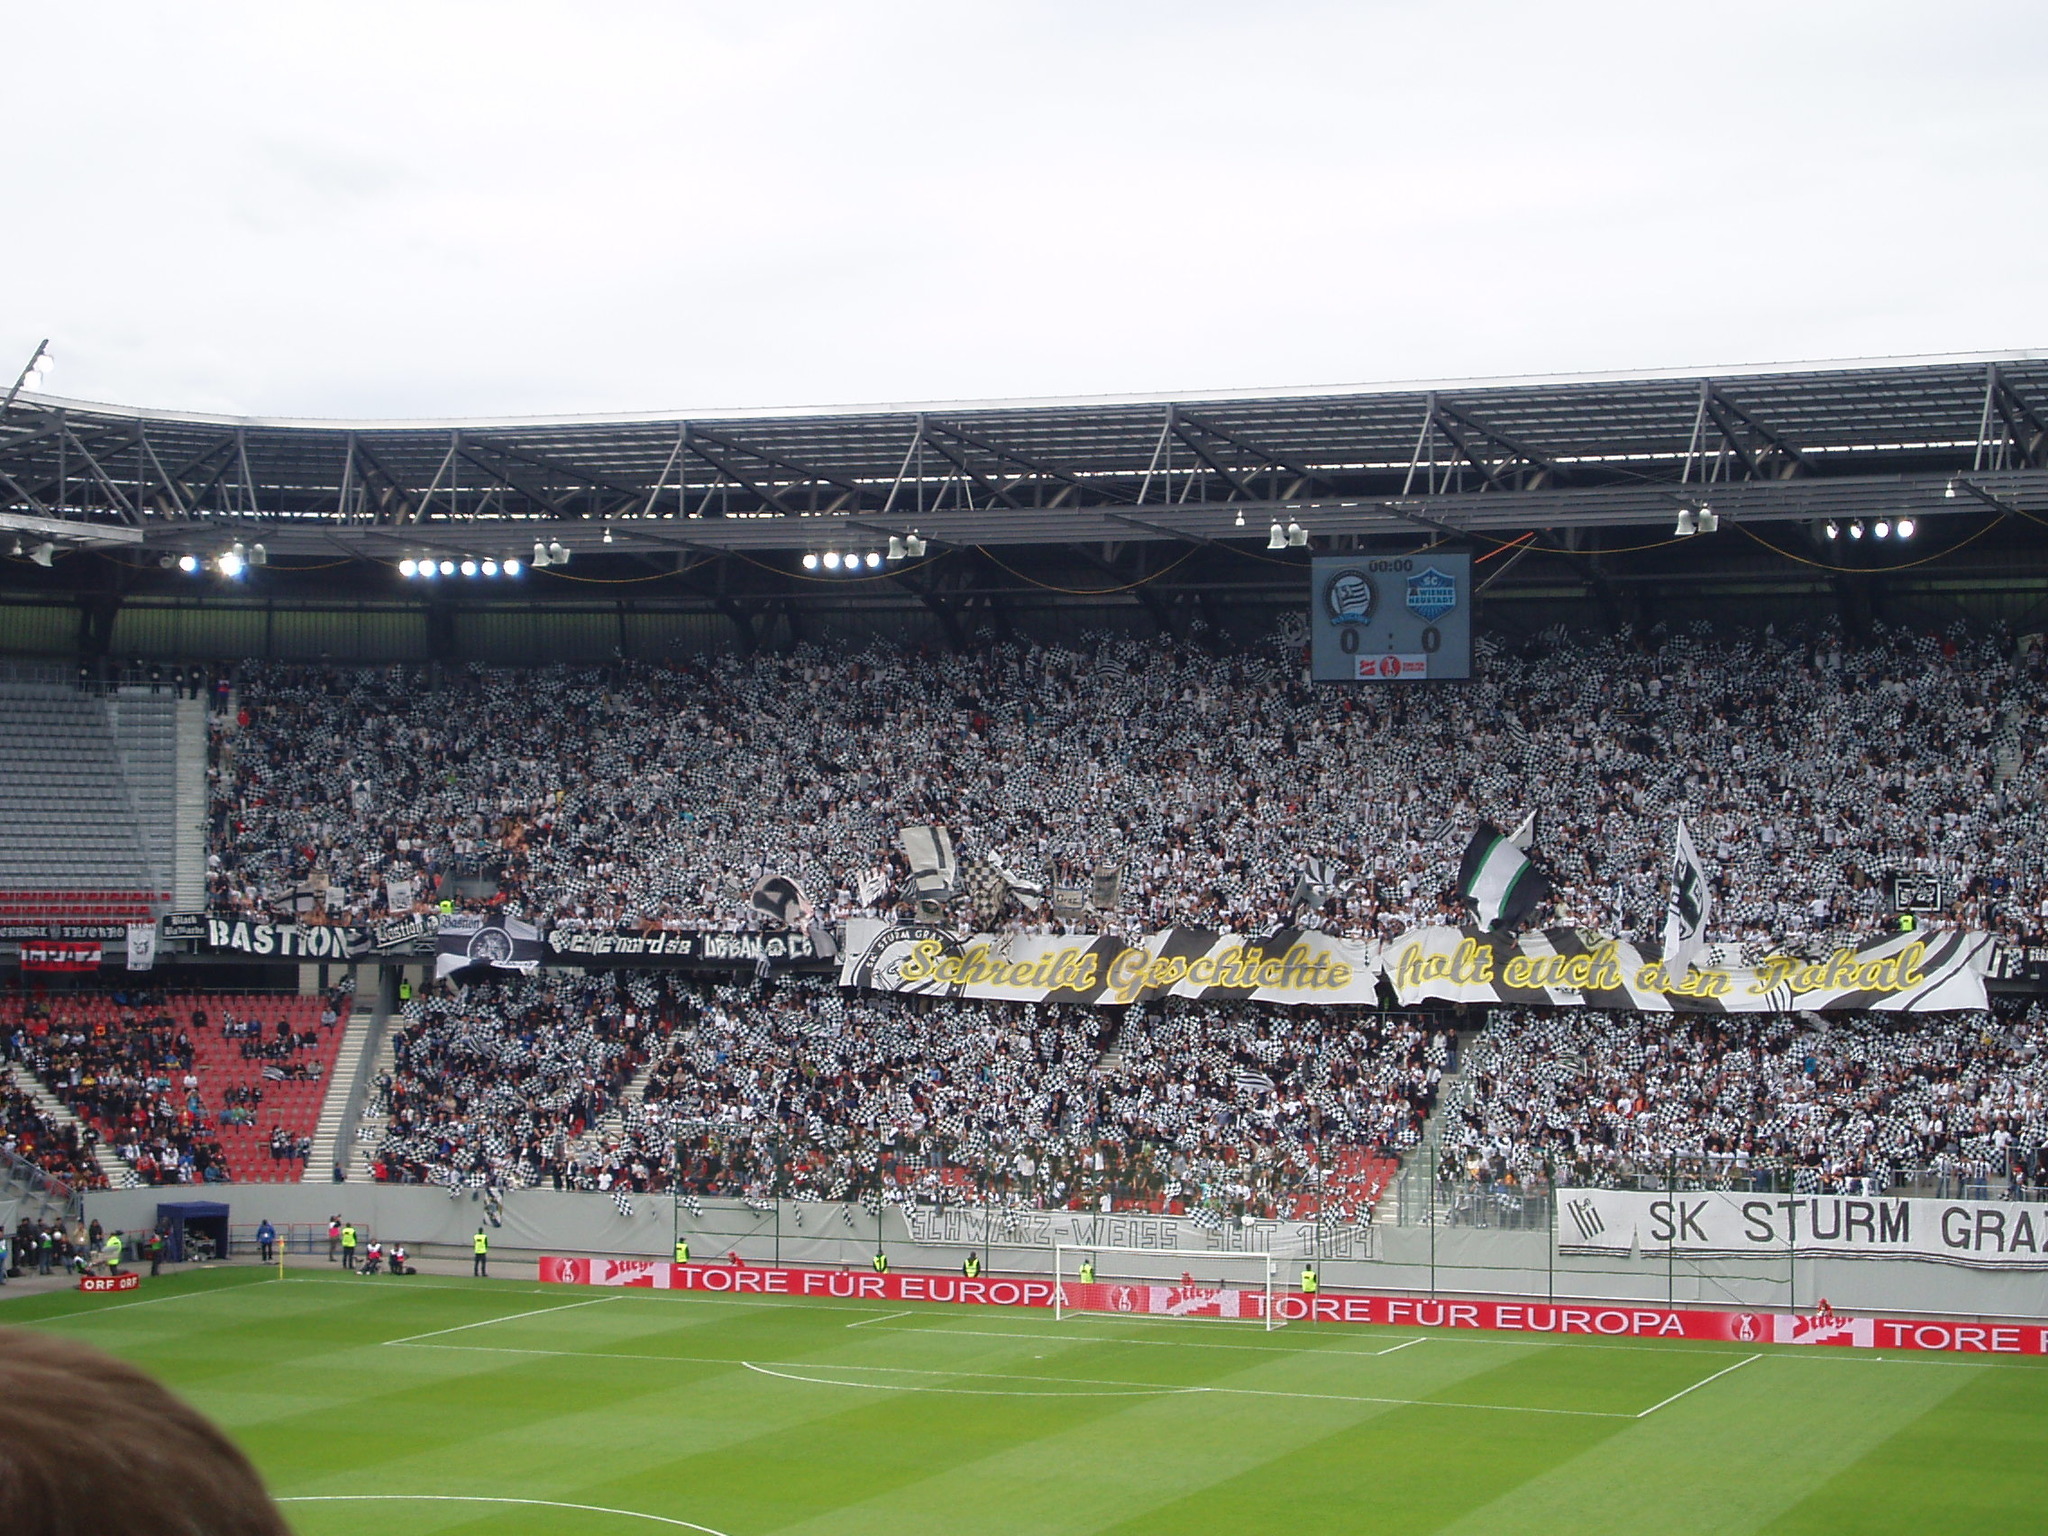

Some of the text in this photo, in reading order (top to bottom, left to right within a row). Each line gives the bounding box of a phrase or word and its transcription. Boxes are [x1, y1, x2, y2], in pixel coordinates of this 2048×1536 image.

[1369, 559, 1413, 573] 00:00
[1423, 576, 1438, 586] SC
[1340, 628, 1359, 654] 0
[1421, 626, 1441, 653] 0
[208, 919, 351, 959] BASTION
[877, 930, 910, 950] STURM
[26, 944, 97, 968] GRAZ
[900, 939, 1098, 992] Schreibt
[1106, 943, 1353, 1003] Geschichte
[1397, 937, 1495, 991] holt
[1503, 939, 1623, 991] euch
[1634, 960, 1731, 998] den
[1746, 941, 1926, 994] Pokal
[1650, 1199, 2048, 1254] SK STURM GRA
[84, 1277, 138, 1290] ORF ORF
[677, 1267, 1070, 1308] TORE FÜR EUROPA
[1248, 1294, 1686, 1337] TORE FÜR EUROPA
[1883, 1322, 2021, 1352] TORE
